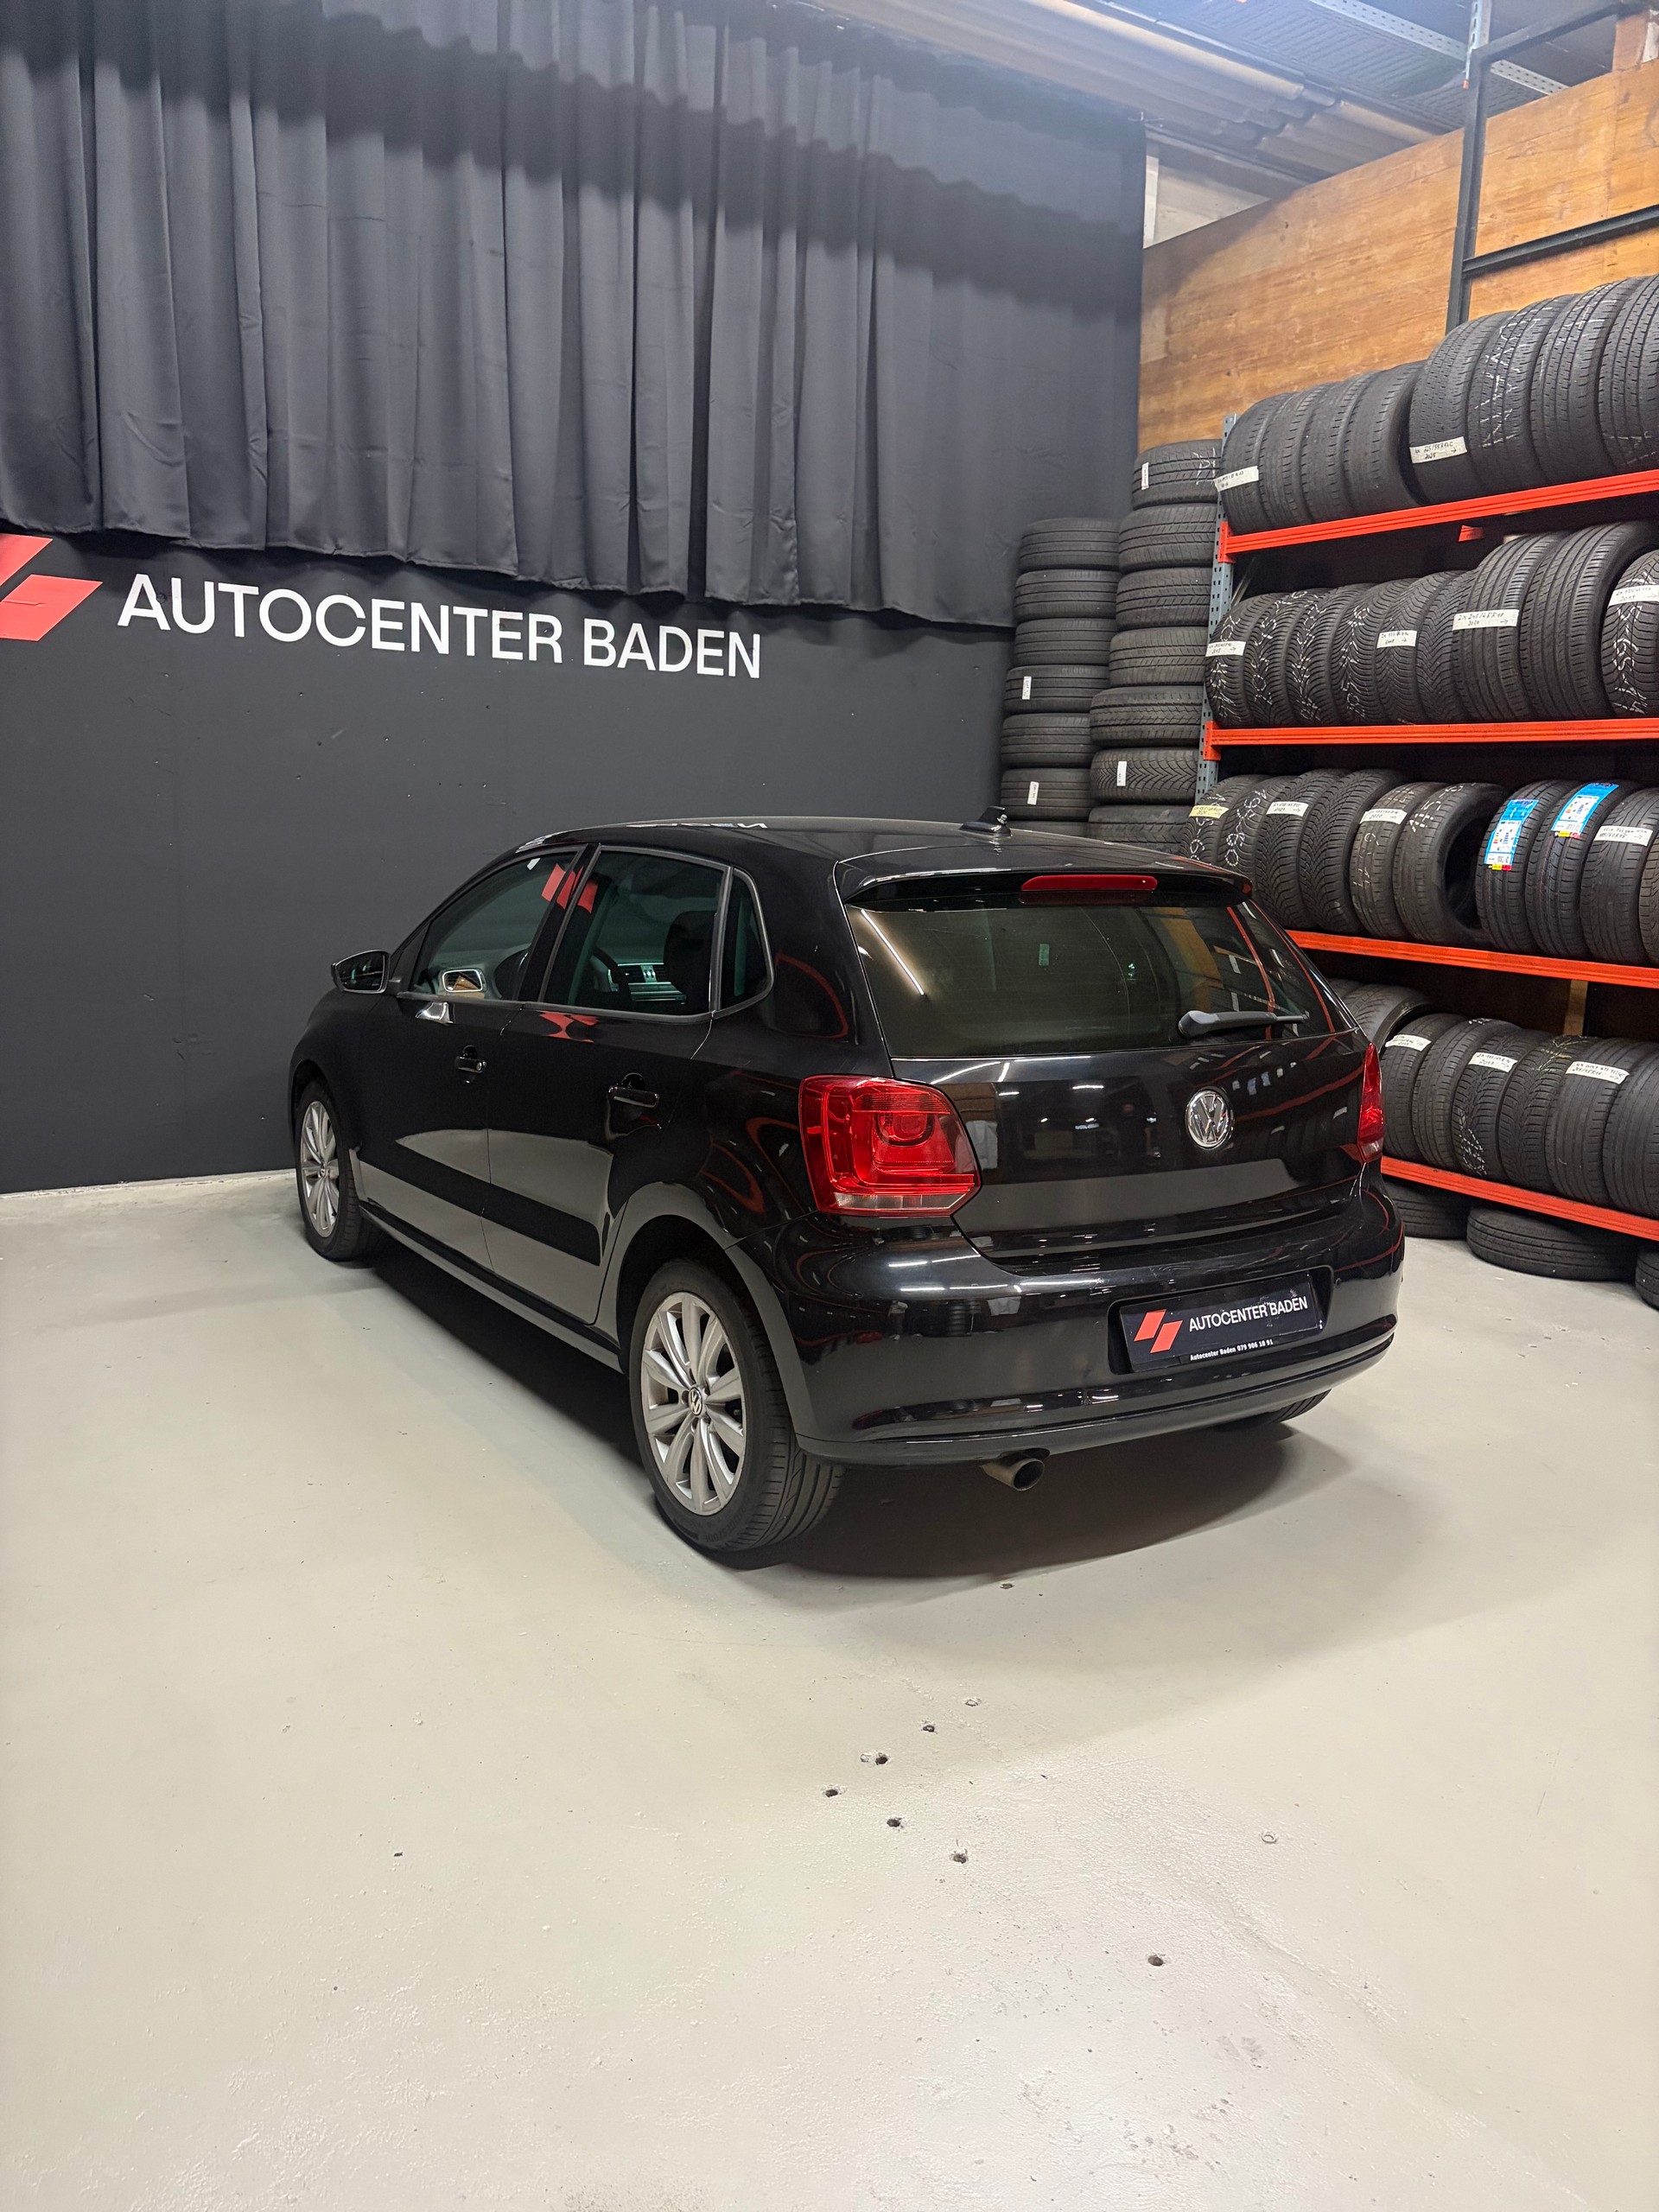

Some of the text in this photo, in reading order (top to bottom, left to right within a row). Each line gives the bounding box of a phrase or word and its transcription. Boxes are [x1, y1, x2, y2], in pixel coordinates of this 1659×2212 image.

[118, 574, 761, 679] AUTOCENTER BADEN
[1189, 1296, 1308, 1332] AUTOCENTER BADEN
[1190, 1350, 1219, 1361] Autocenter
[1248, 1341, 1258, 1350] 906
